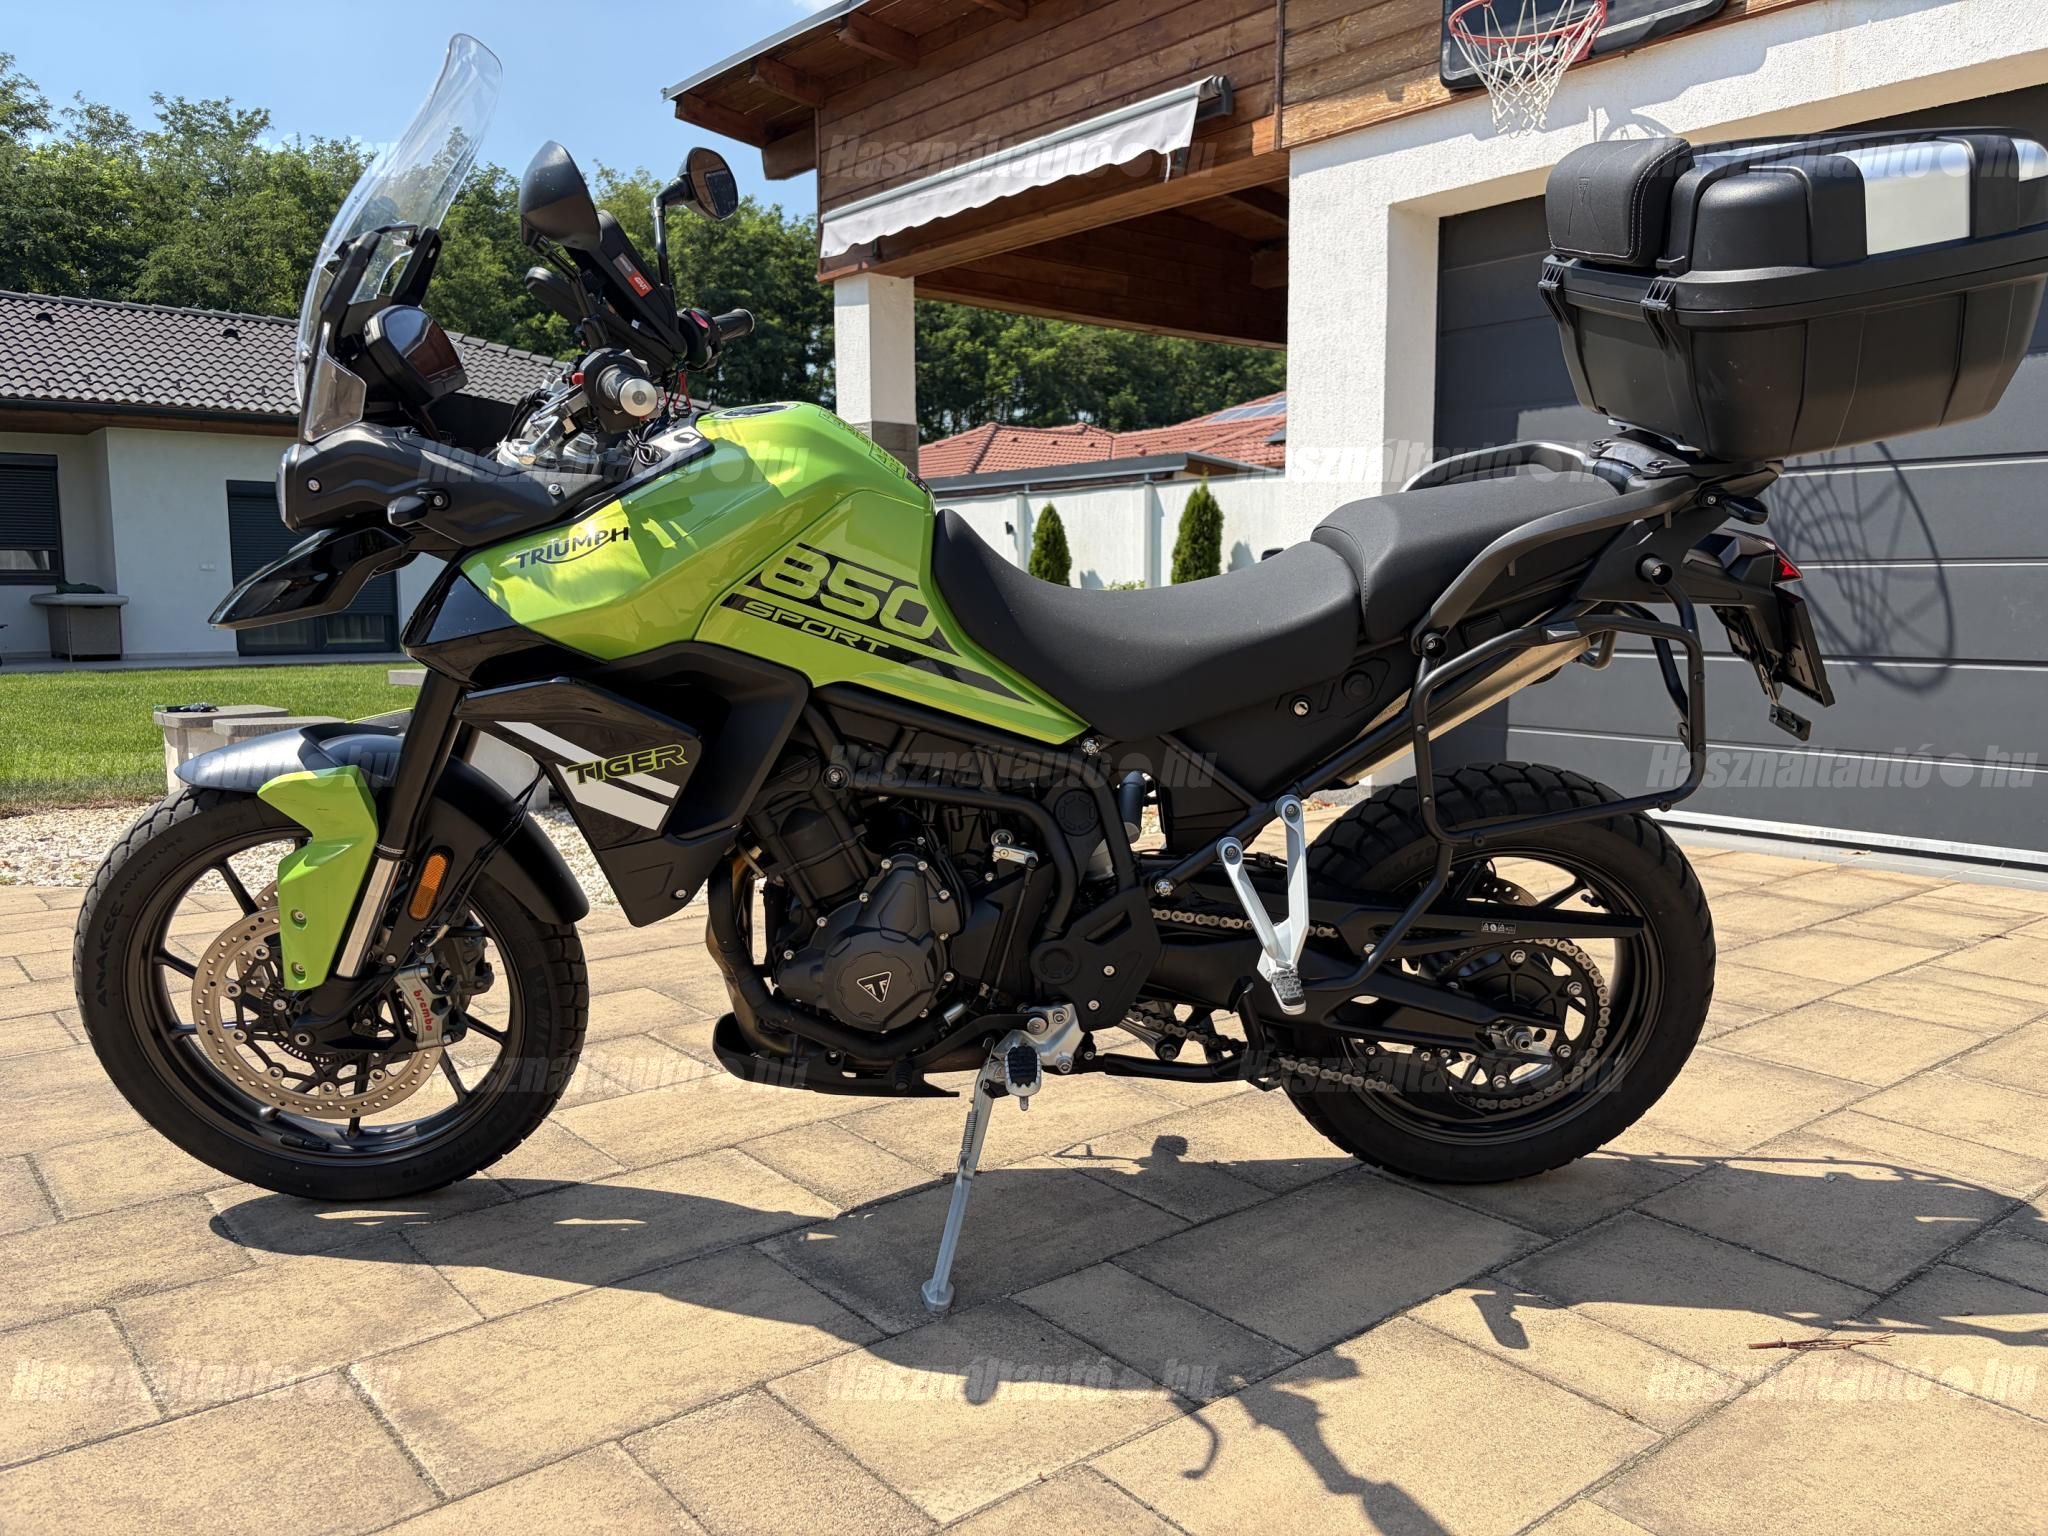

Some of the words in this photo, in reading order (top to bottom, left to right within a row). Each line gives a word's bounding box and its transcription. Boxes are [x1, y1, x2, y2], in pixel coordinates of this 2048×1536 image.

[516, 527, 630, 569] TRIUMPH
[759, 550, 938, 641] 850
[743, 600, 890, 654] SPORT
[566, 744, 689, 786] TIGER
[413, 989, 433, 1032] brembo
